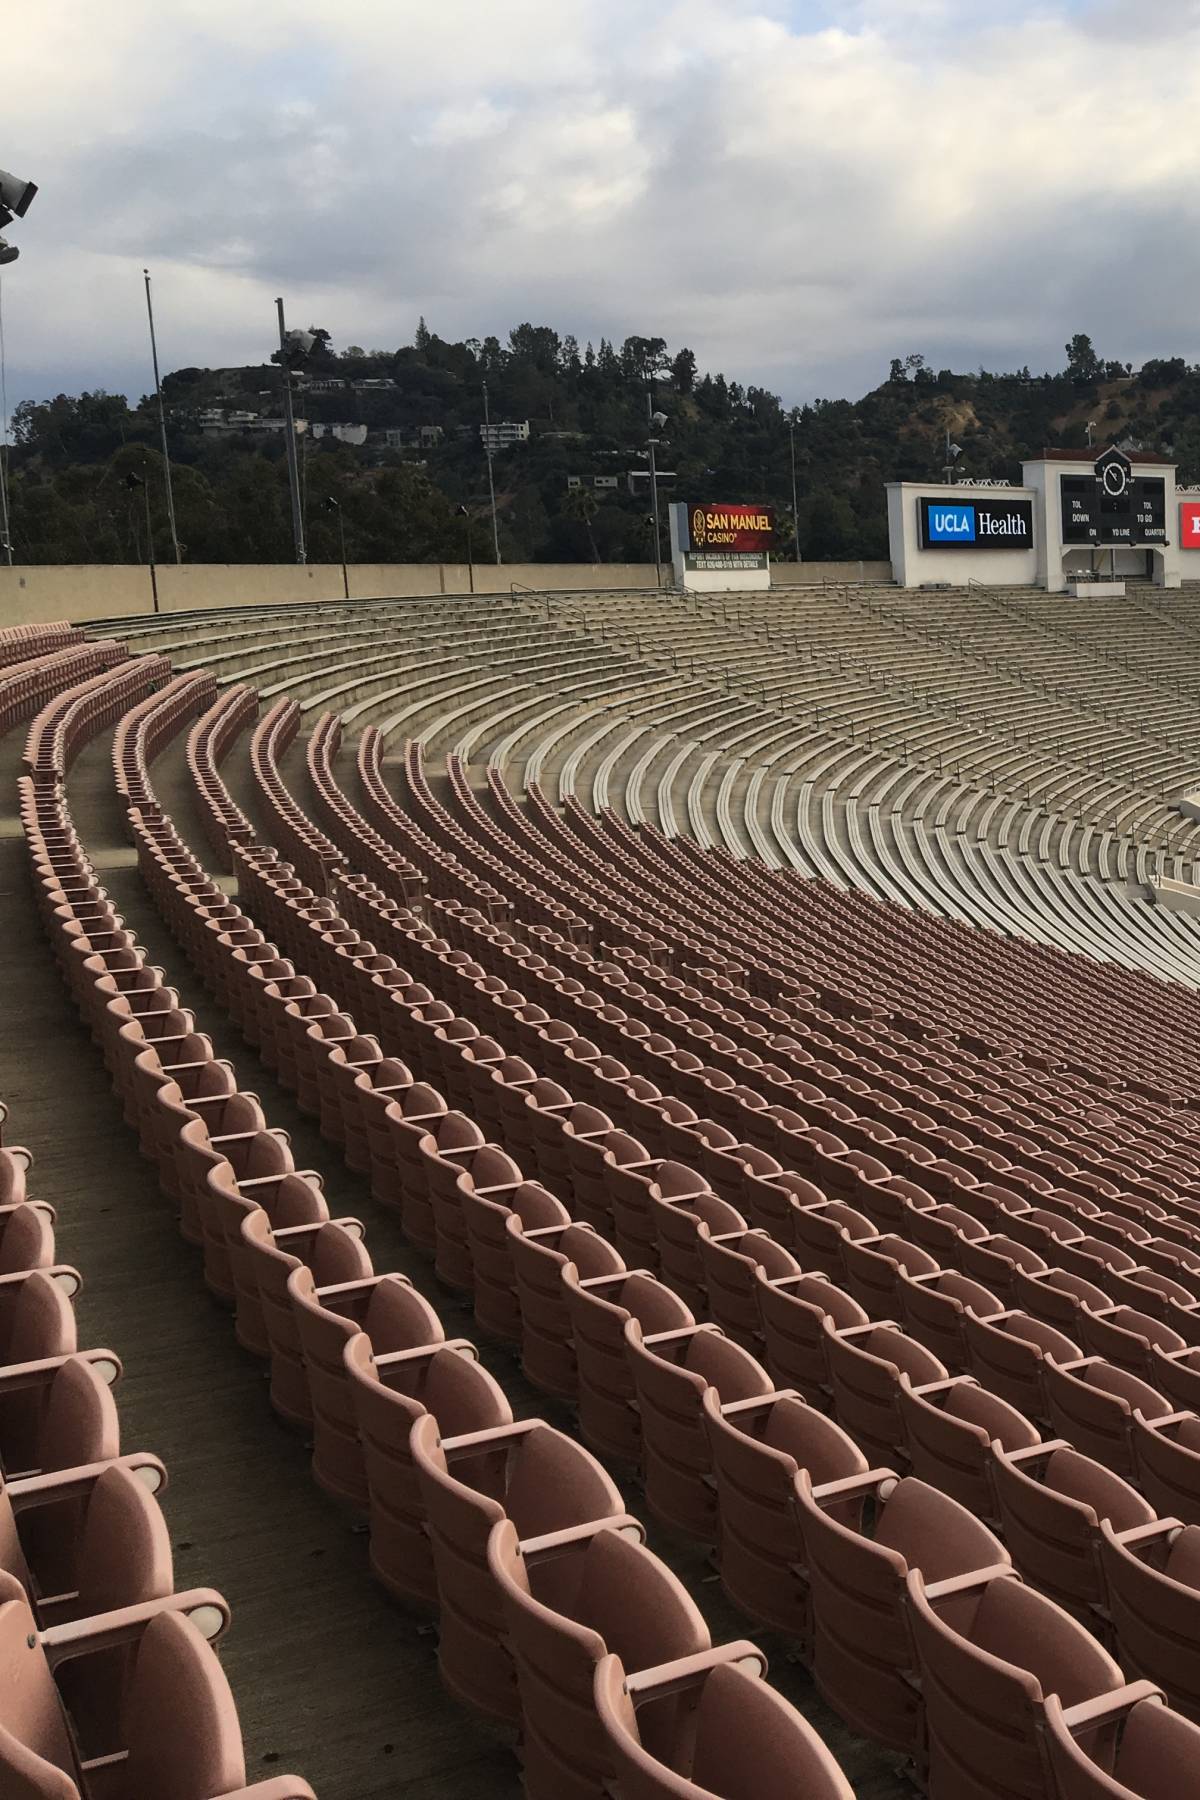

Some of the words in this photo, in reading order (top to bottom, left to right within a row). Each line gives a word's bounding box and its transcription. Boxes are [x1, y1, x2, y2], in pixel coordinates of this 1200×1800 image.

[706, 513, 728, 529] SAN
[730, 514, 772, 531] MANUEL
[1072, 514, 1090, 522] DOWN
[1137, 514, 1144, 522] TO
[934, 514, 970, 532] UCLA
[978, 513, 1027, 535] Health
[1089, 528, 1097, 536] ON
[1144, 528, 1165, 536] QUARTER
